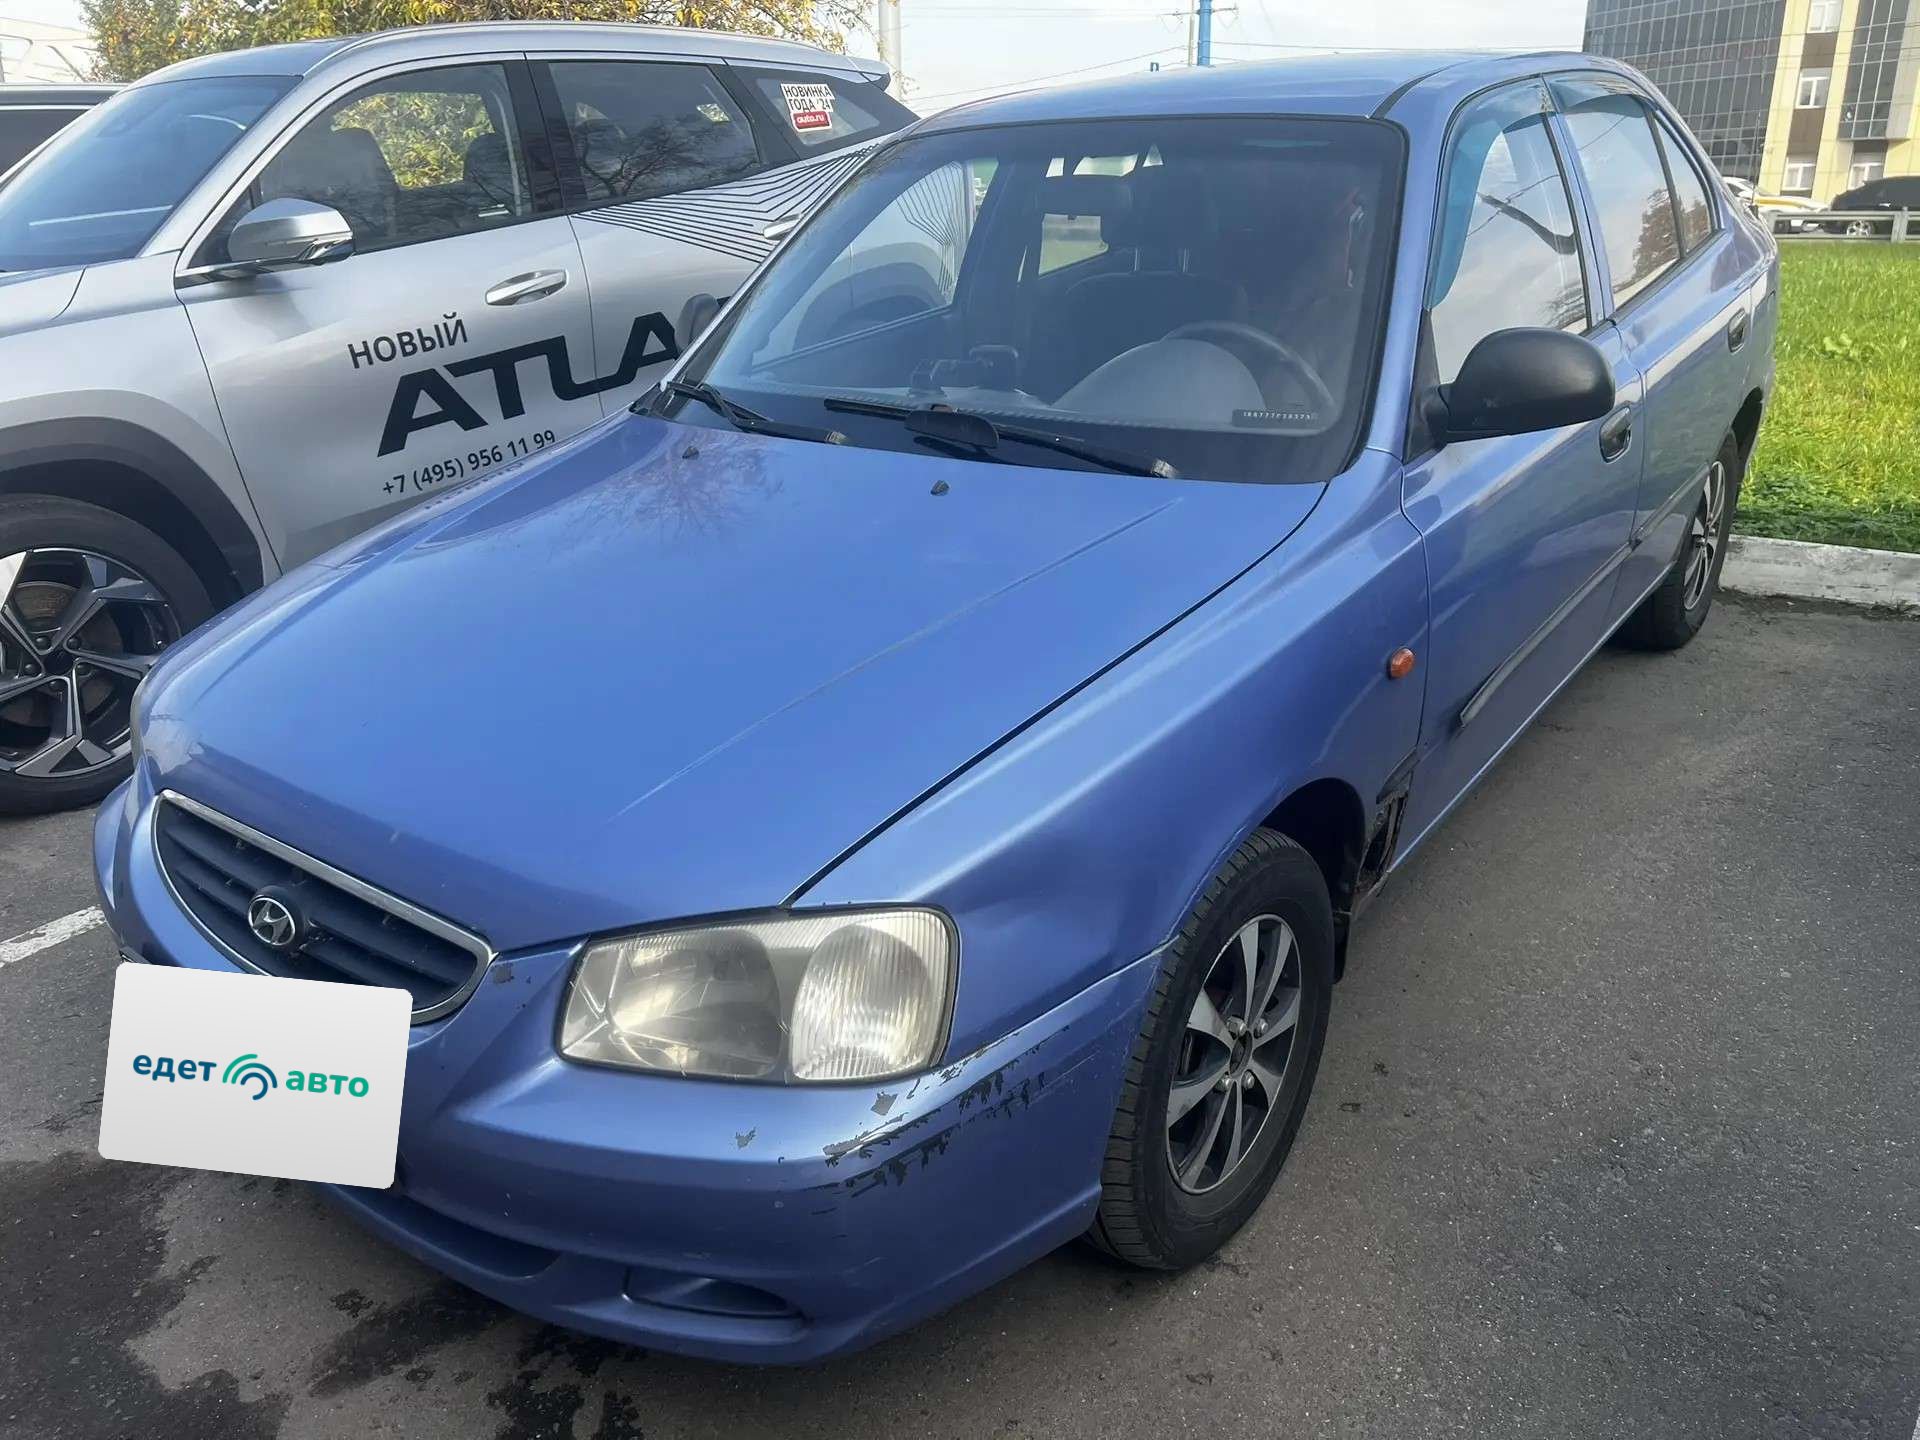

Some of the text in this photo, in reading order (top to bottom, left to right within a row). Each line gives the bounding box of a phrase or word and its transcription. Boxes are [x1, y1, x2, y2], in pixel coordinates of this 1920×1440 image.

[784, 86, 832, 98] НОВИНКА
[788, 99, 816, 112] ГОДА
[796, 114, 825, 123] auto.ru
[347, 311, 468, 369] НОВЫЙ
[377, 296, 730, 457] ATLA
[383, 430, 556, 495] +7 (495) 956 11 99
